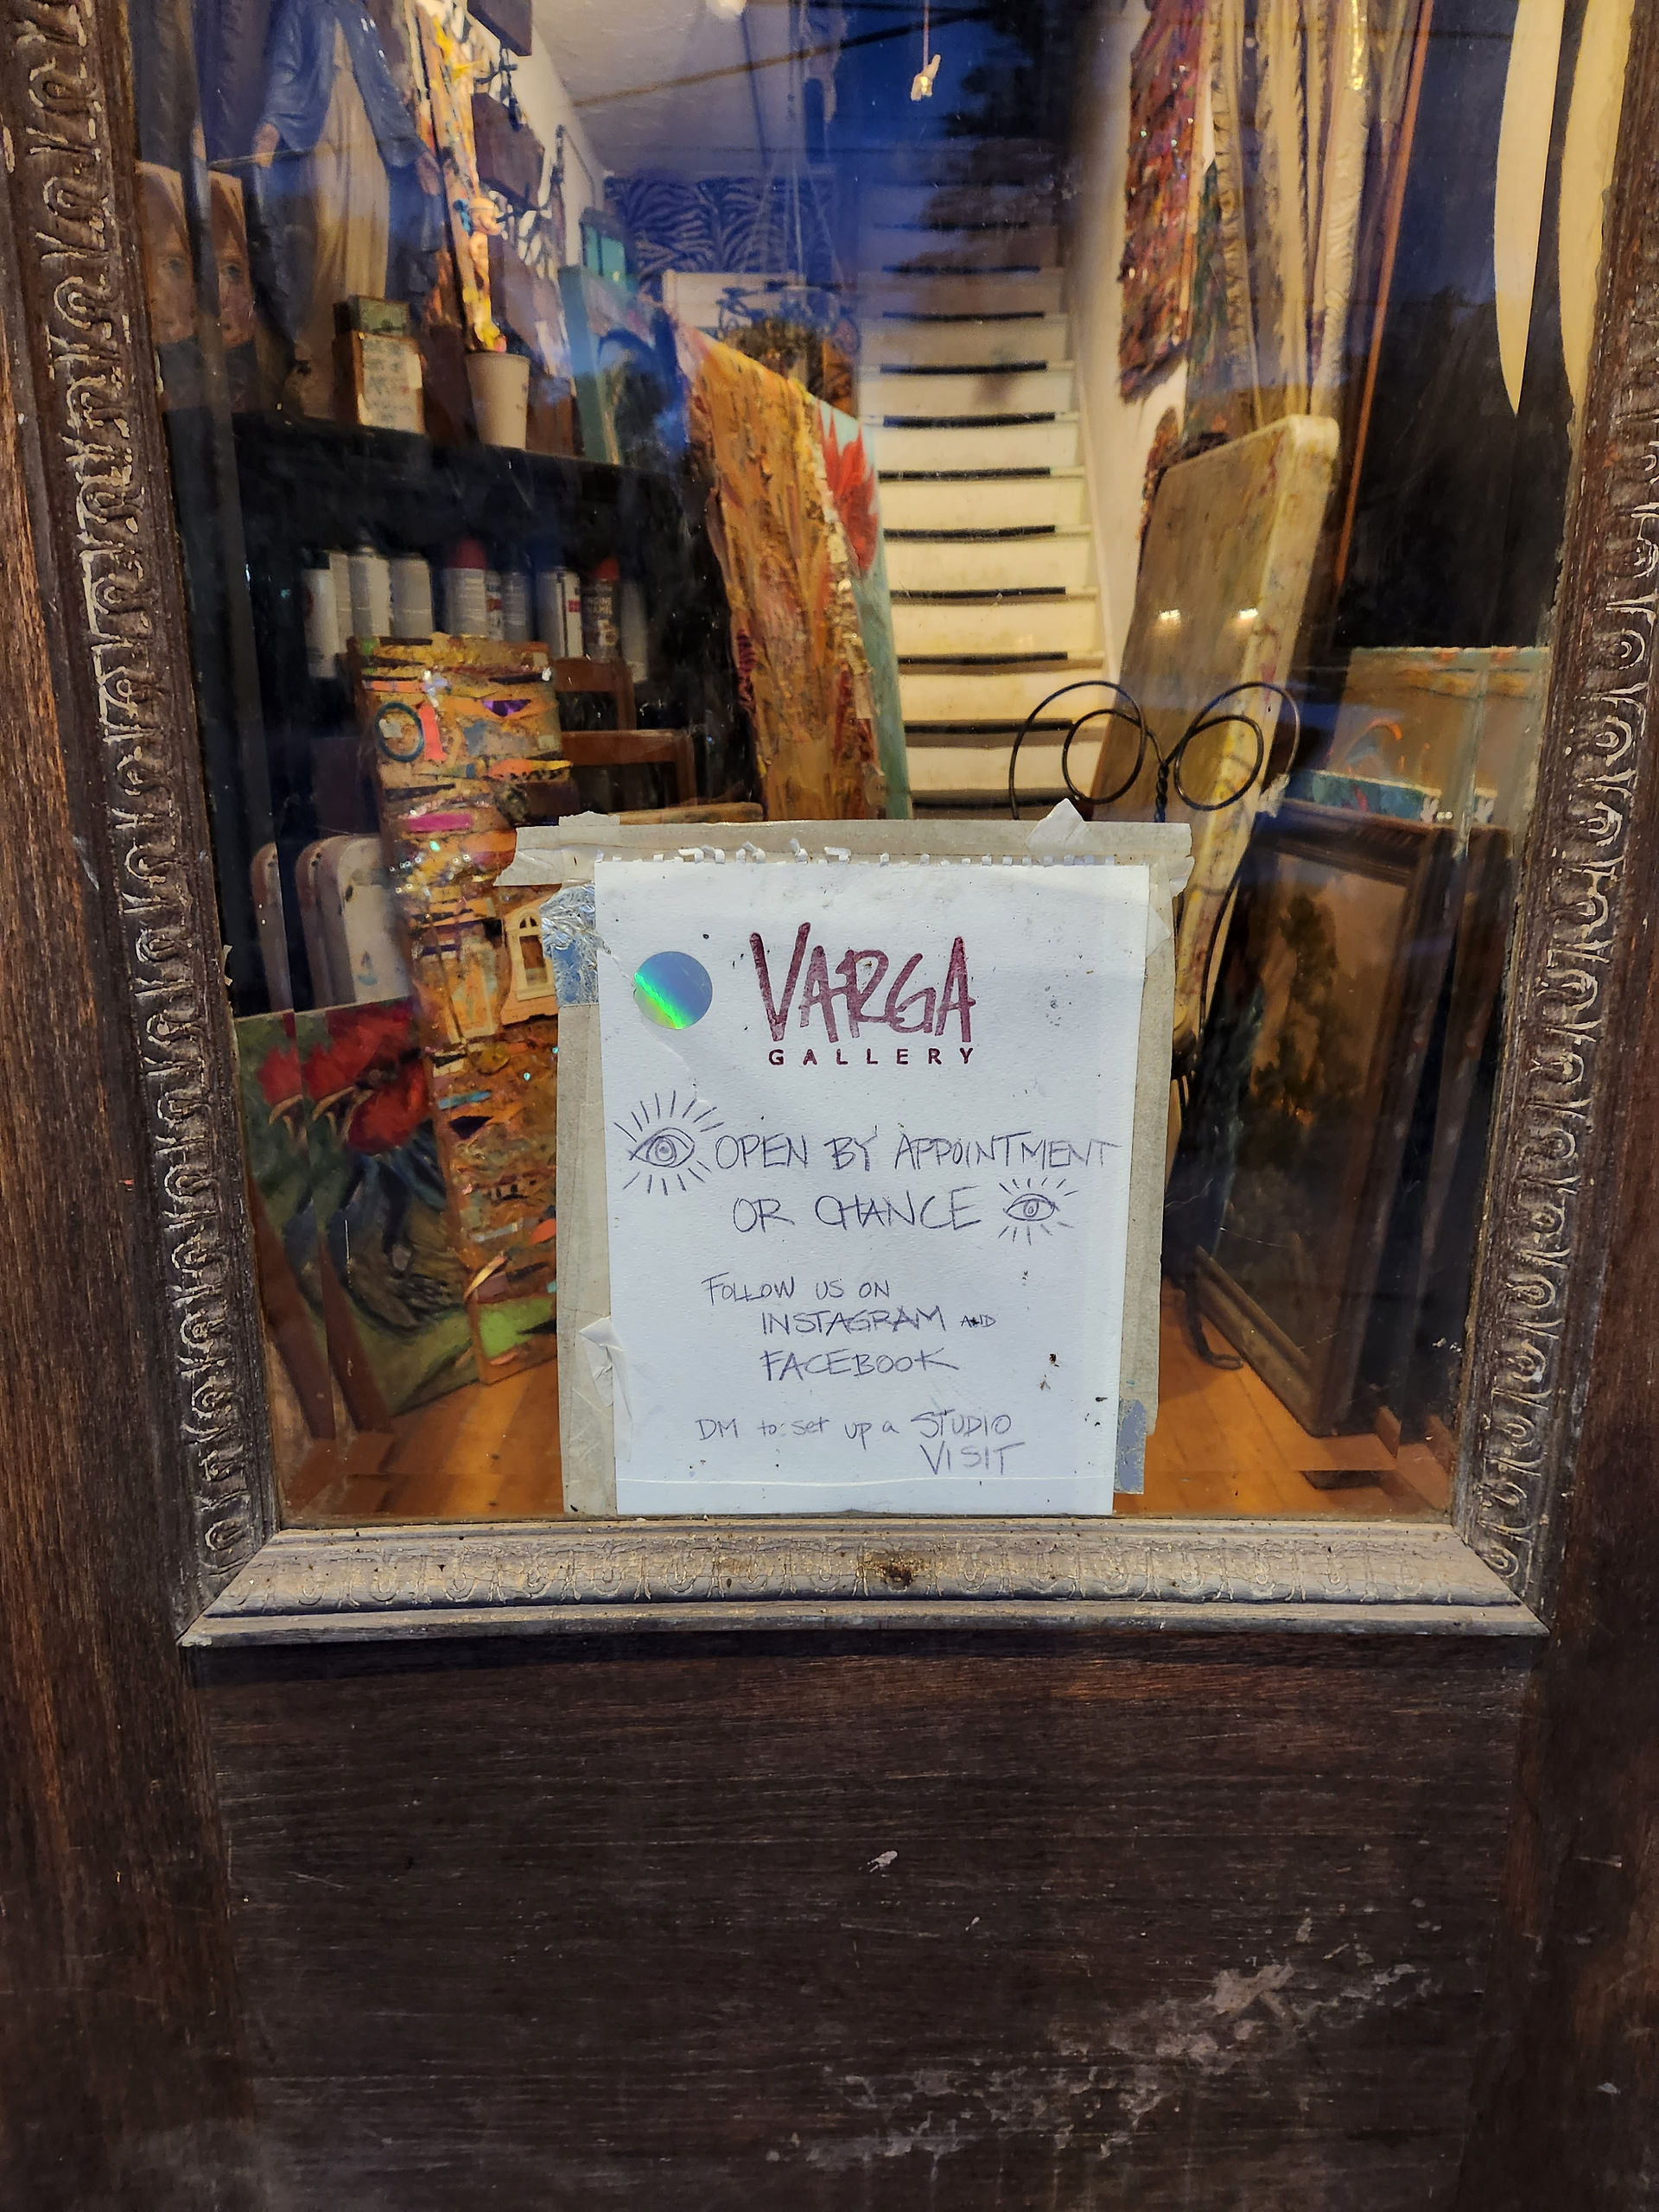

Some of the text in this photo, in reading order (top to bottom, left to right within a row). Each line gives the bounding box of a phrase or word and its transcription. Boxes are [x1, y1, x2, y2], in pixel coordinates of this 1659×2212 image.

[748, 922, 976, 1042] VARGA
[768, 1047, 973, 1066] GALLERY
[715, 1125, 1121, 1173] OPEN BY APPOINTMENT
[732, 1185, 985, 1233] OR CHANCE
[858, 1278, 891, 1300] ON
[762, 1306, 947, 1336] INSTAGRAM
[760, 1347, 959, 1382] FACEBOOK
[695, 1418, 740, 1442] DM
[845, 1421, 871, 1451] up
[882, 1422, 899, 1434] a
[910, 1408, 1012, 1440] STUDIO
[919, 1441, 1027, 1476] VISIT
